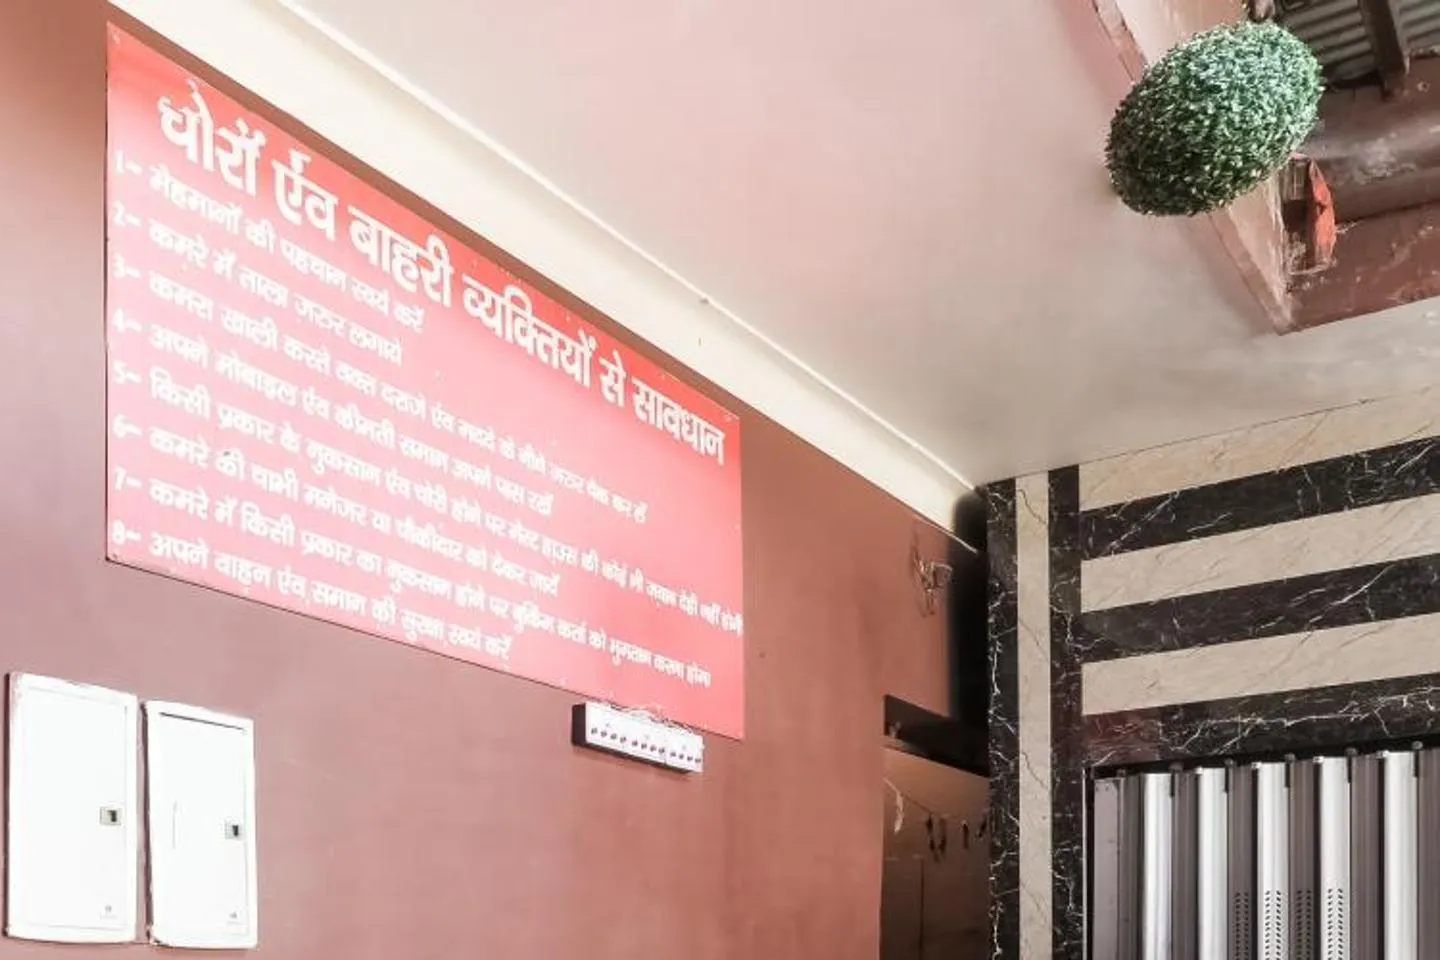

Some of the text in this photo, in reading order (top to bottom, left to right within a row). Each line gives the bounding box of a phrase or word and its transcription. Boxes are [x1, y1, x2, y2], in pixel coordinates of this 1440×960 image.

[112, 200, 141, 227] 2-
[148, 218, 209, 268] कमरे
[213, 249, 236, 278] में
[238, 265, 288, 308] ताला
[113, 252, 140, 278] 3-
[220, 306, 278, 350] खाली
[283, 335, 331, 375] करते
[148, 163, 243, 234] मेहमानों
[244, 218, 275, 252] की
[279, 238, 348, 292] पहचान
[393, 302, 424, 333] करें
[112, 307, 142, 332] 4-
[148, 323, 209, 367] अपने
[214, 351, 299, 405] मोबाइल
[451, 458, 491, 489] अपने
[494, 475, 525, 504] पास
[347, 204, 453, 307] बाहरी
[462, 273, 598, 388] व्यक्तियों
[599, 348, 626, 407] से
[631, 376, 726, 465] सावधान
[112, 359, 141, 384] 5-
[148, 365, 211, 418] किसी
[216, 402, 276, 444] प्रकार
[279, 421, 300, 453] के
[305, 437, 382, 486] नुकसान
[483, 511, 506, 536] पर
[112, 413, 141, 438] 6-
[149, 426, 210, 468] कमरे
[214, 447, 246, 480] की
[370, 509, 391, 533] या
[464, 546, 487, 569] को
[111, 520, 141, 545] 8-
[148, 531, 209, 569] अपने
[214, 551, 272, 588] वाहन
[371, 596, 396, 624] की
[484, 634, 512, 660] करें
[113, 465, 142, 491] 7-
[148, 477, 210, 520] कमरे
[214, 495, 237, 525] में
[239, 501, 295, 546] किसी
[299, 529, 353, 565] प्रकार
[355, 548, 382, 574] का
[383, 558, 452, 599] नुकसान
[488, 595, 511, 618] पर
